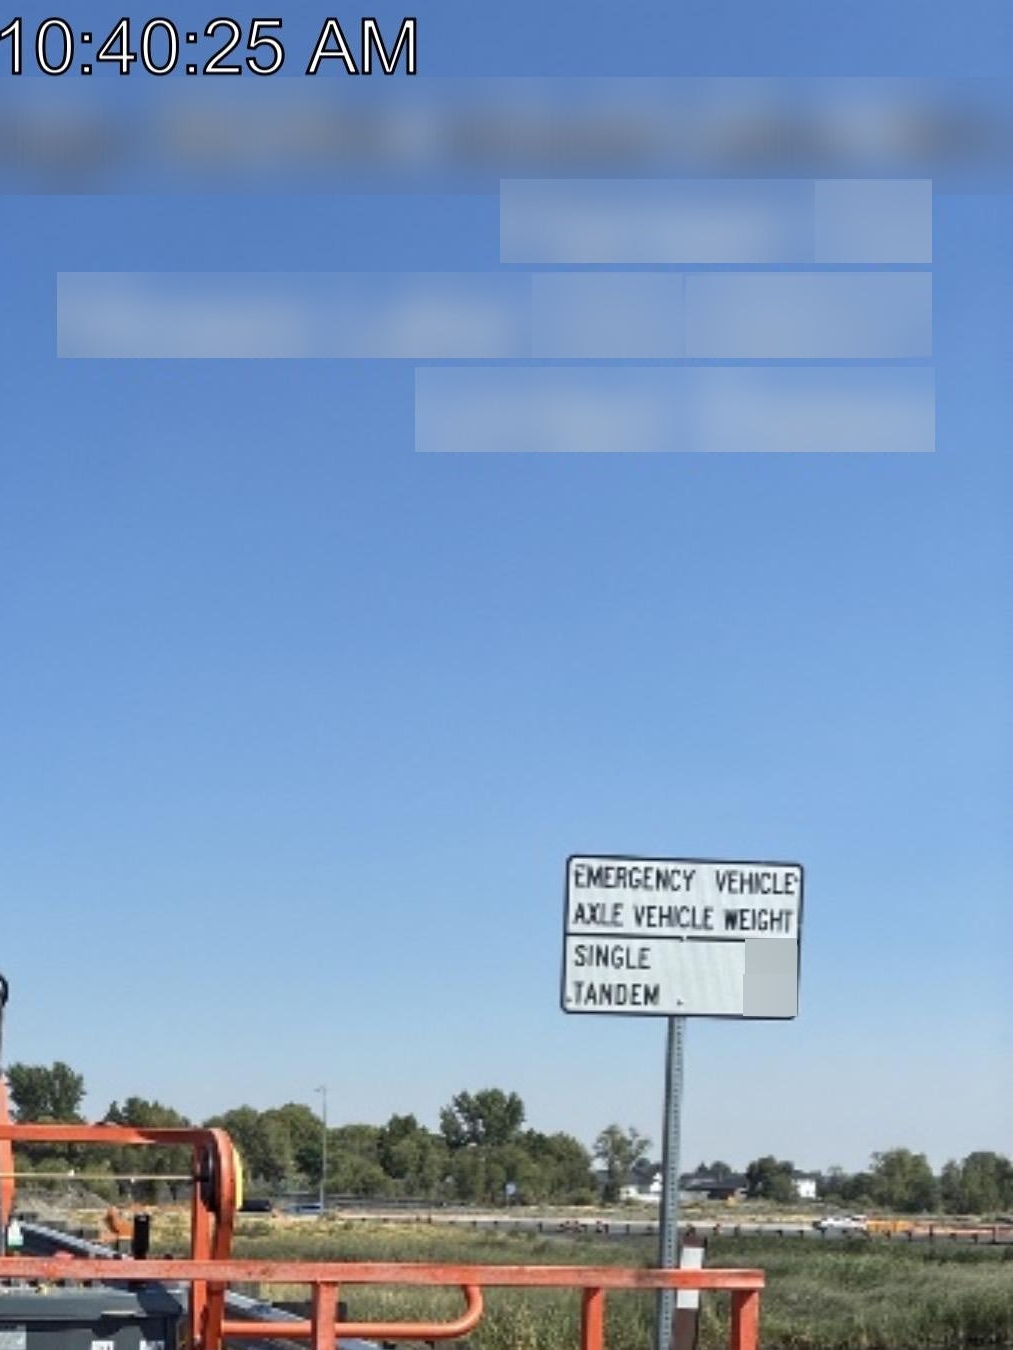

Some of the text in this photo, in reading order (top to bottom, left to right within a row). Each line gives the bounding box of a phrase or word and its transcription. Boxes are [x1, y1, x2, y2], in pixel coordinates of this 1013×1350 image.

[573, 863, 796, 895] EMERGENCY VEHICLE
[572, 902, 793, 933] AXLE VEHICLE WEIGHT
[574, 944, 651, 969] SINGLE
[573, 981, 660, 1006] TANDEM
